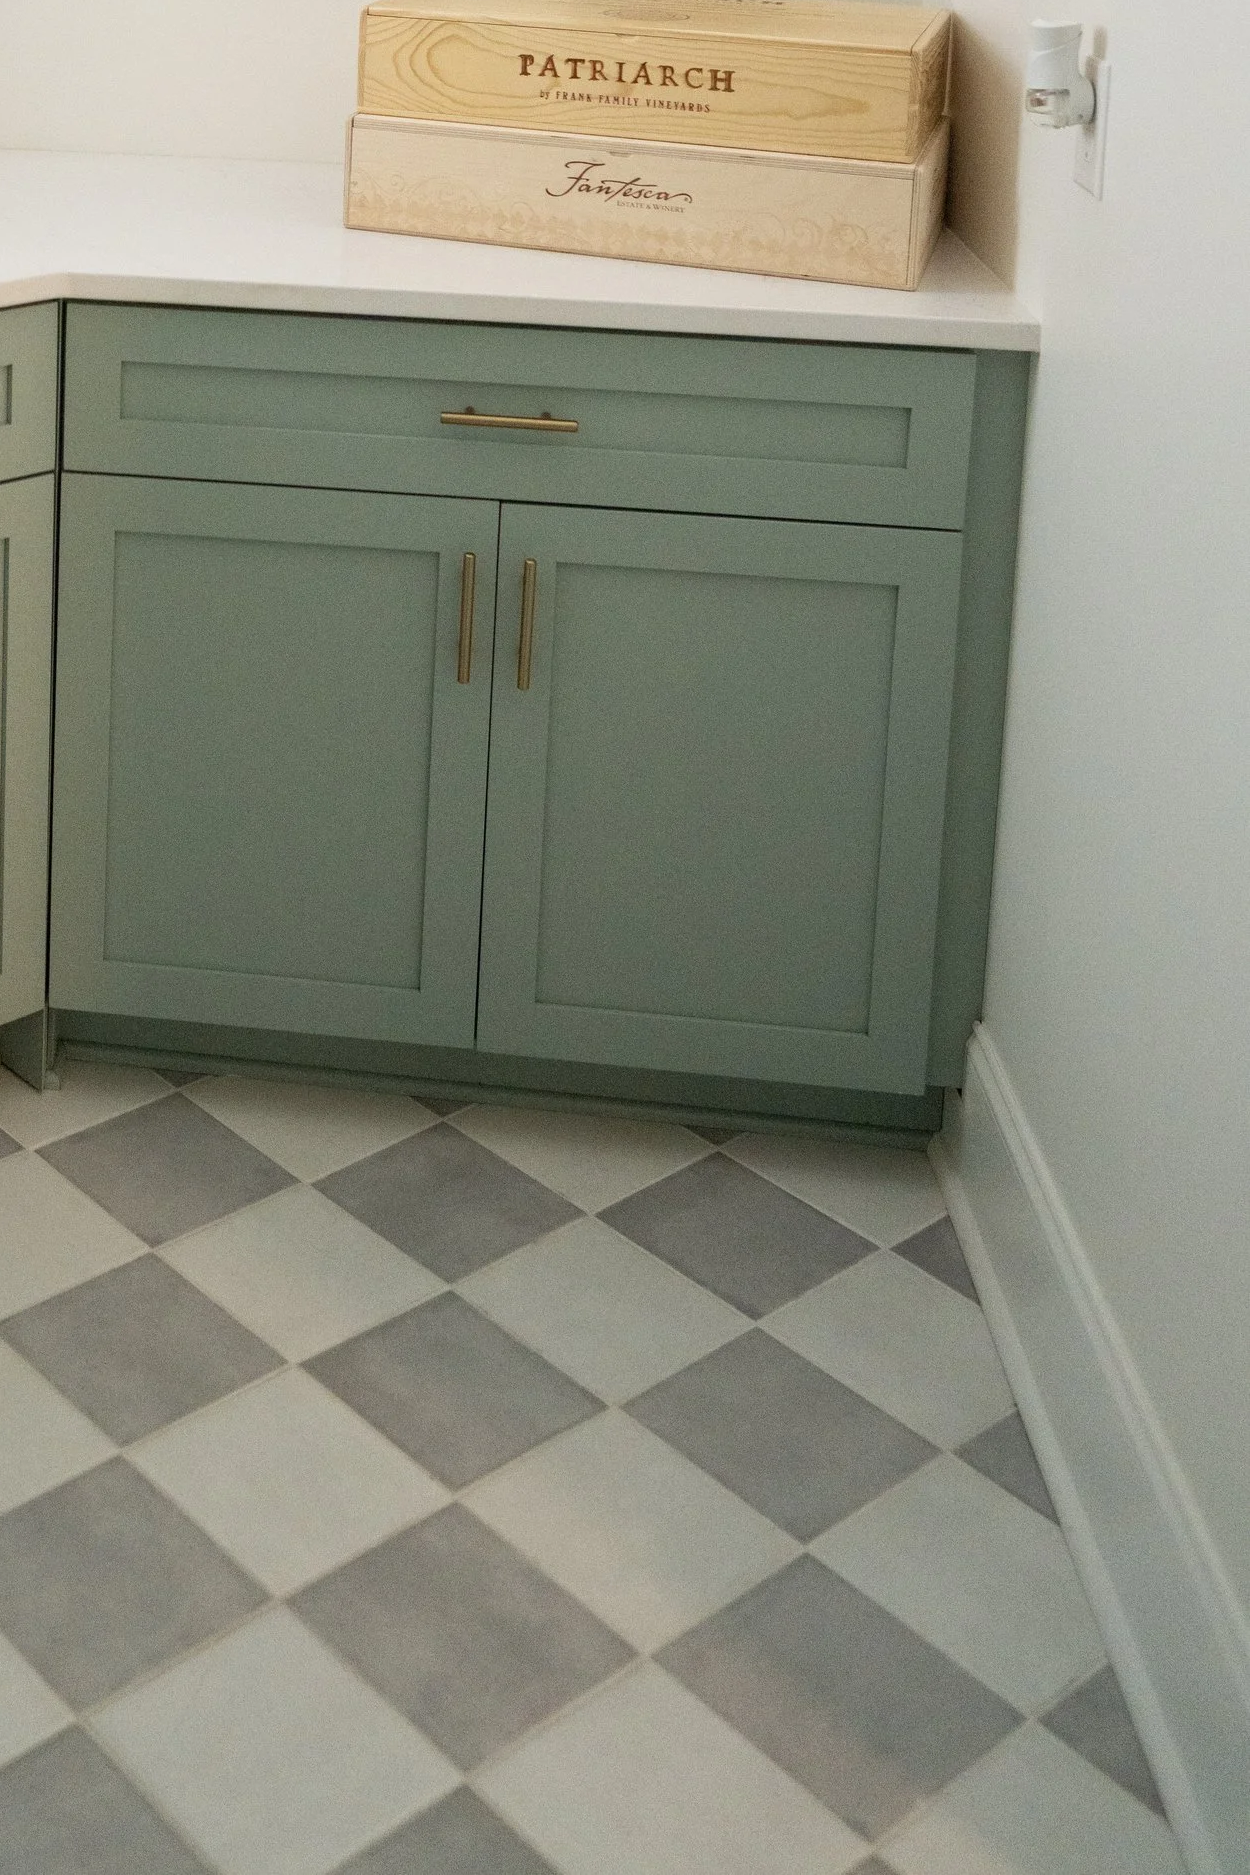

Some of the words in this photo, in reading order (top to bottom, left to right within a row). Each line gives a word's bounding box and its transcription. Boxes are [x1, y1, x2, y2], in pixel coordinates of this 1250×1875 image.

[518, 54, 736, 92] PATRIARCH
[540, 89, 550, 100] by
[556, 91, 592, 102] FRANK
[599, 94, 639, 106] FAMILY
[646, 98, 710, 113] VINEYARDS
[545, 161, 693, 203] Fantesca
[616, 200, 643, 209] ESTATE
[653, 203, 686, 214] WINERY
